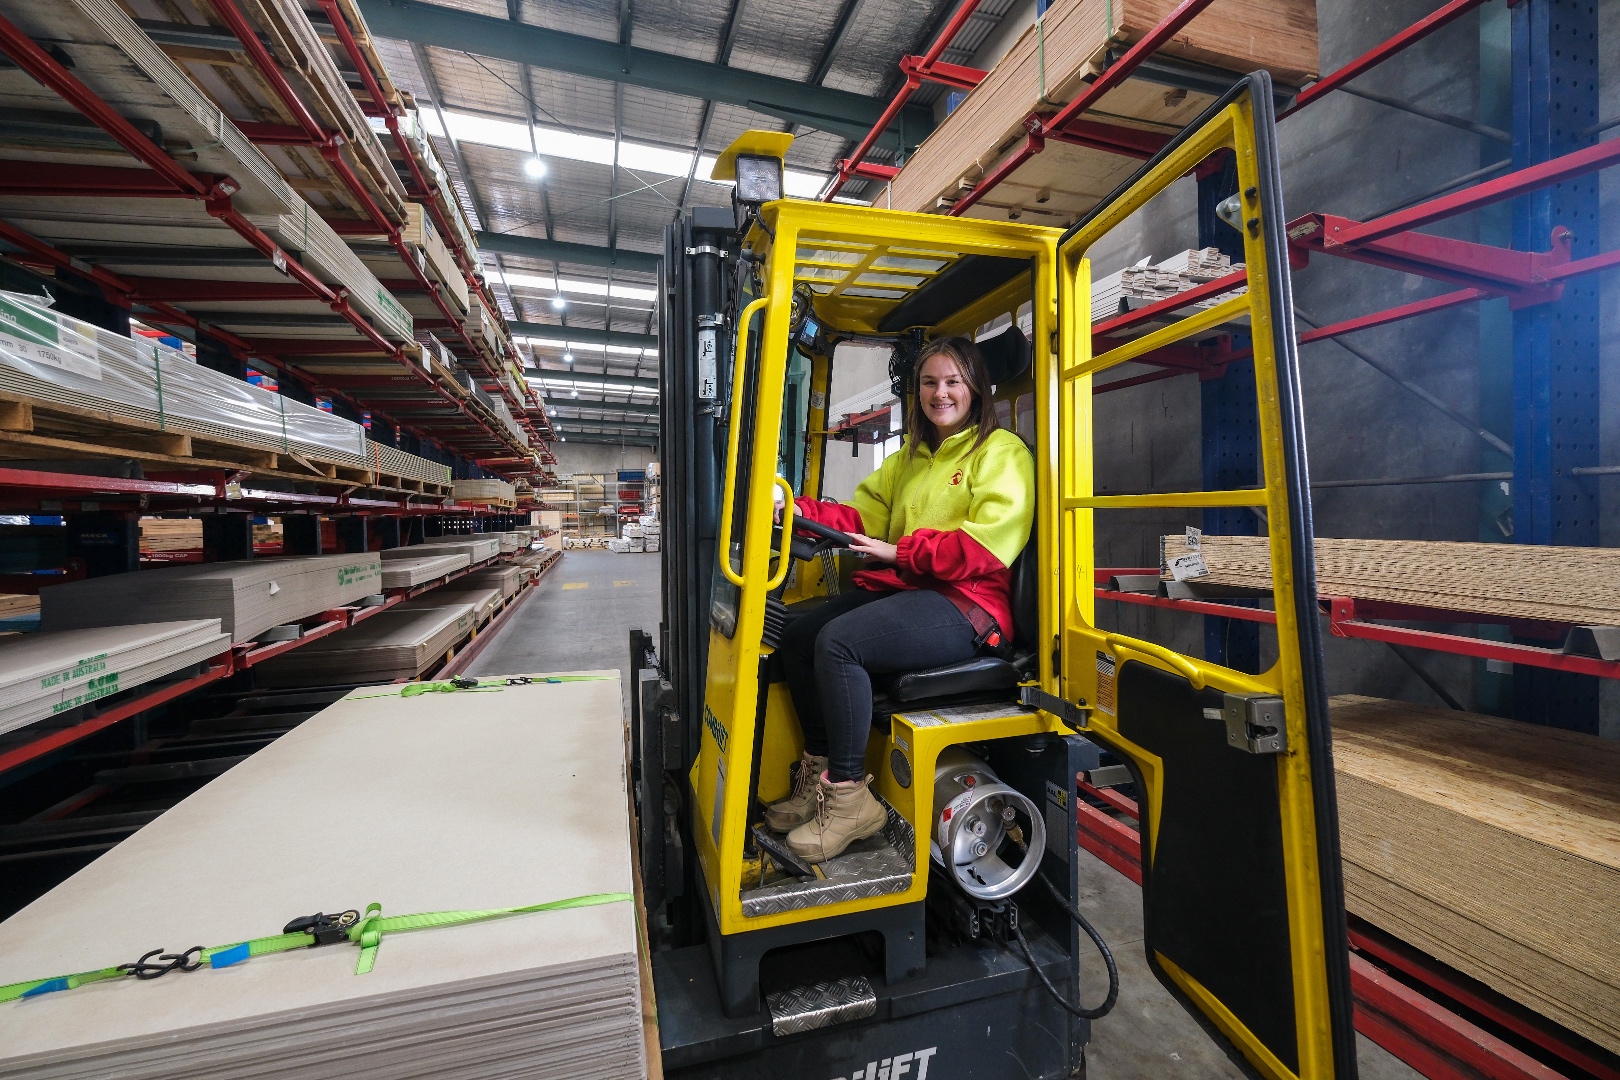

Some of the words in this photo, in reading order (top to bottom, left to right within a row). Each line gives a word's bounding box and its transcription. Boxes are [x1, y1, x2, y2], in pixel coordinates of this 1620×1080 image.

[41, 674, 61, 690] MADE
[62, 671, 70, 682] IN
[73, 662, 106, 679] AUSTRALIA
[84, 684, 119, 703] AUSTRALIA
